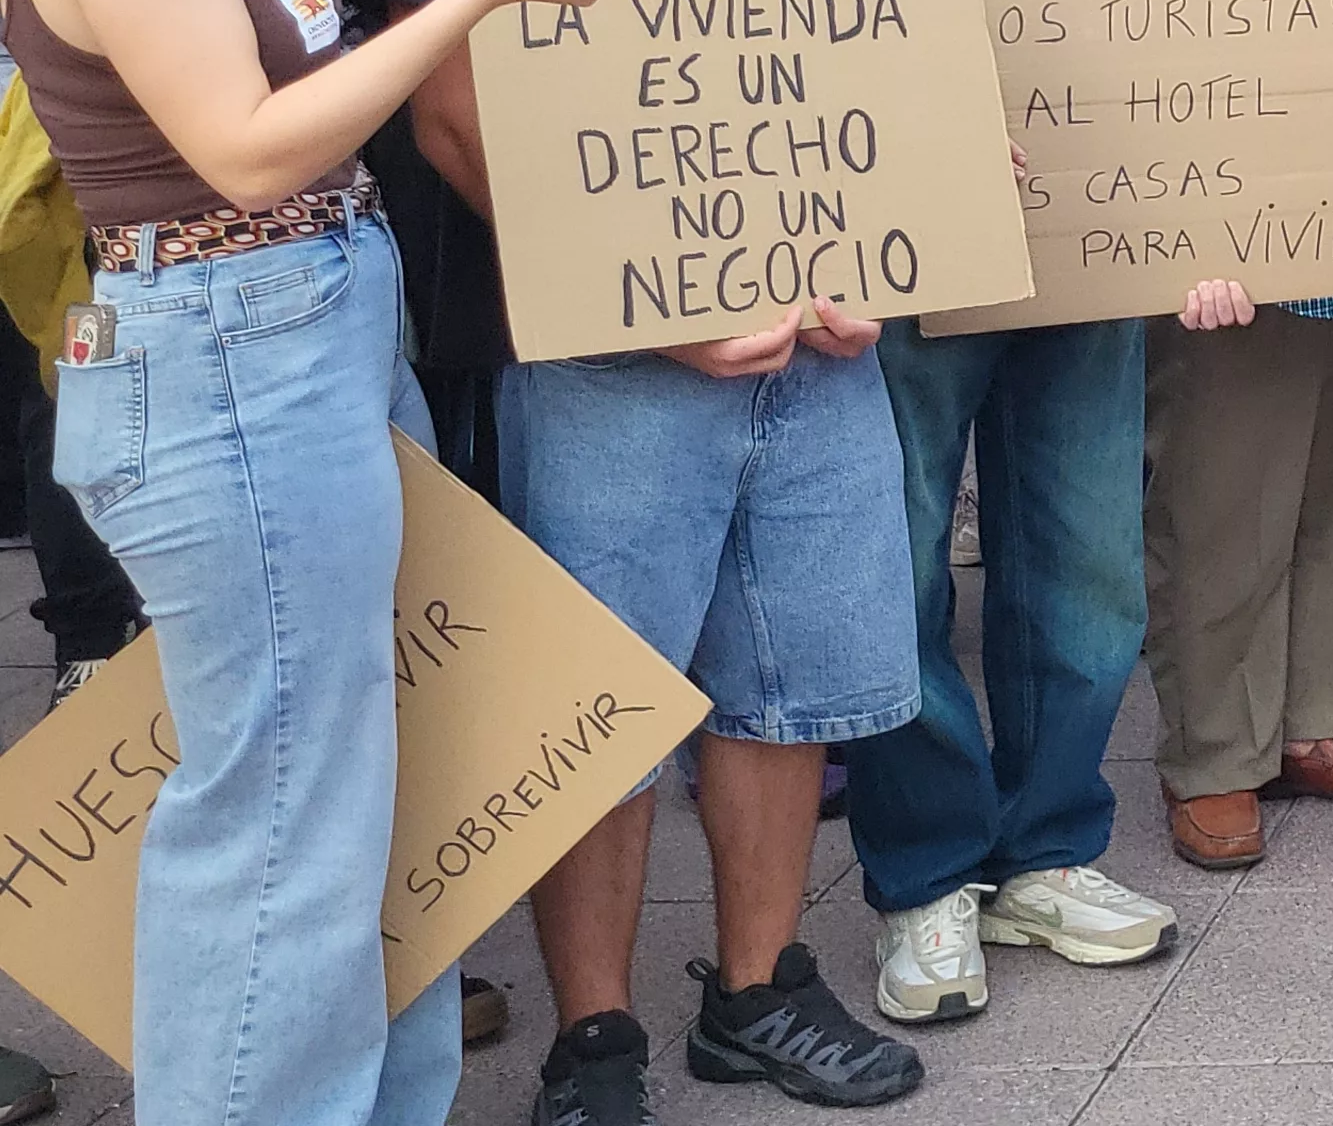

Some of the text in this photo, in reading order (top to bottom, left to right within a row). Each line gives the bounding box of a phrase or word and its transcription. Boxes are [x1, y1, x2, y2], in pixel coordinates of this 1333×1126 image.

[637, 50, 806, 108] ES UN
[1024, 73, 1290, 130] AL HOTEL
[575, 106, 878, 195] DERECHO
[1085, 156, 1244, 205] CASAS
[671, 187, 848, 242] NO UN
[1080, 227, 1197, 269] PARA
[621, 227, 920, 328] NEGOCIO
